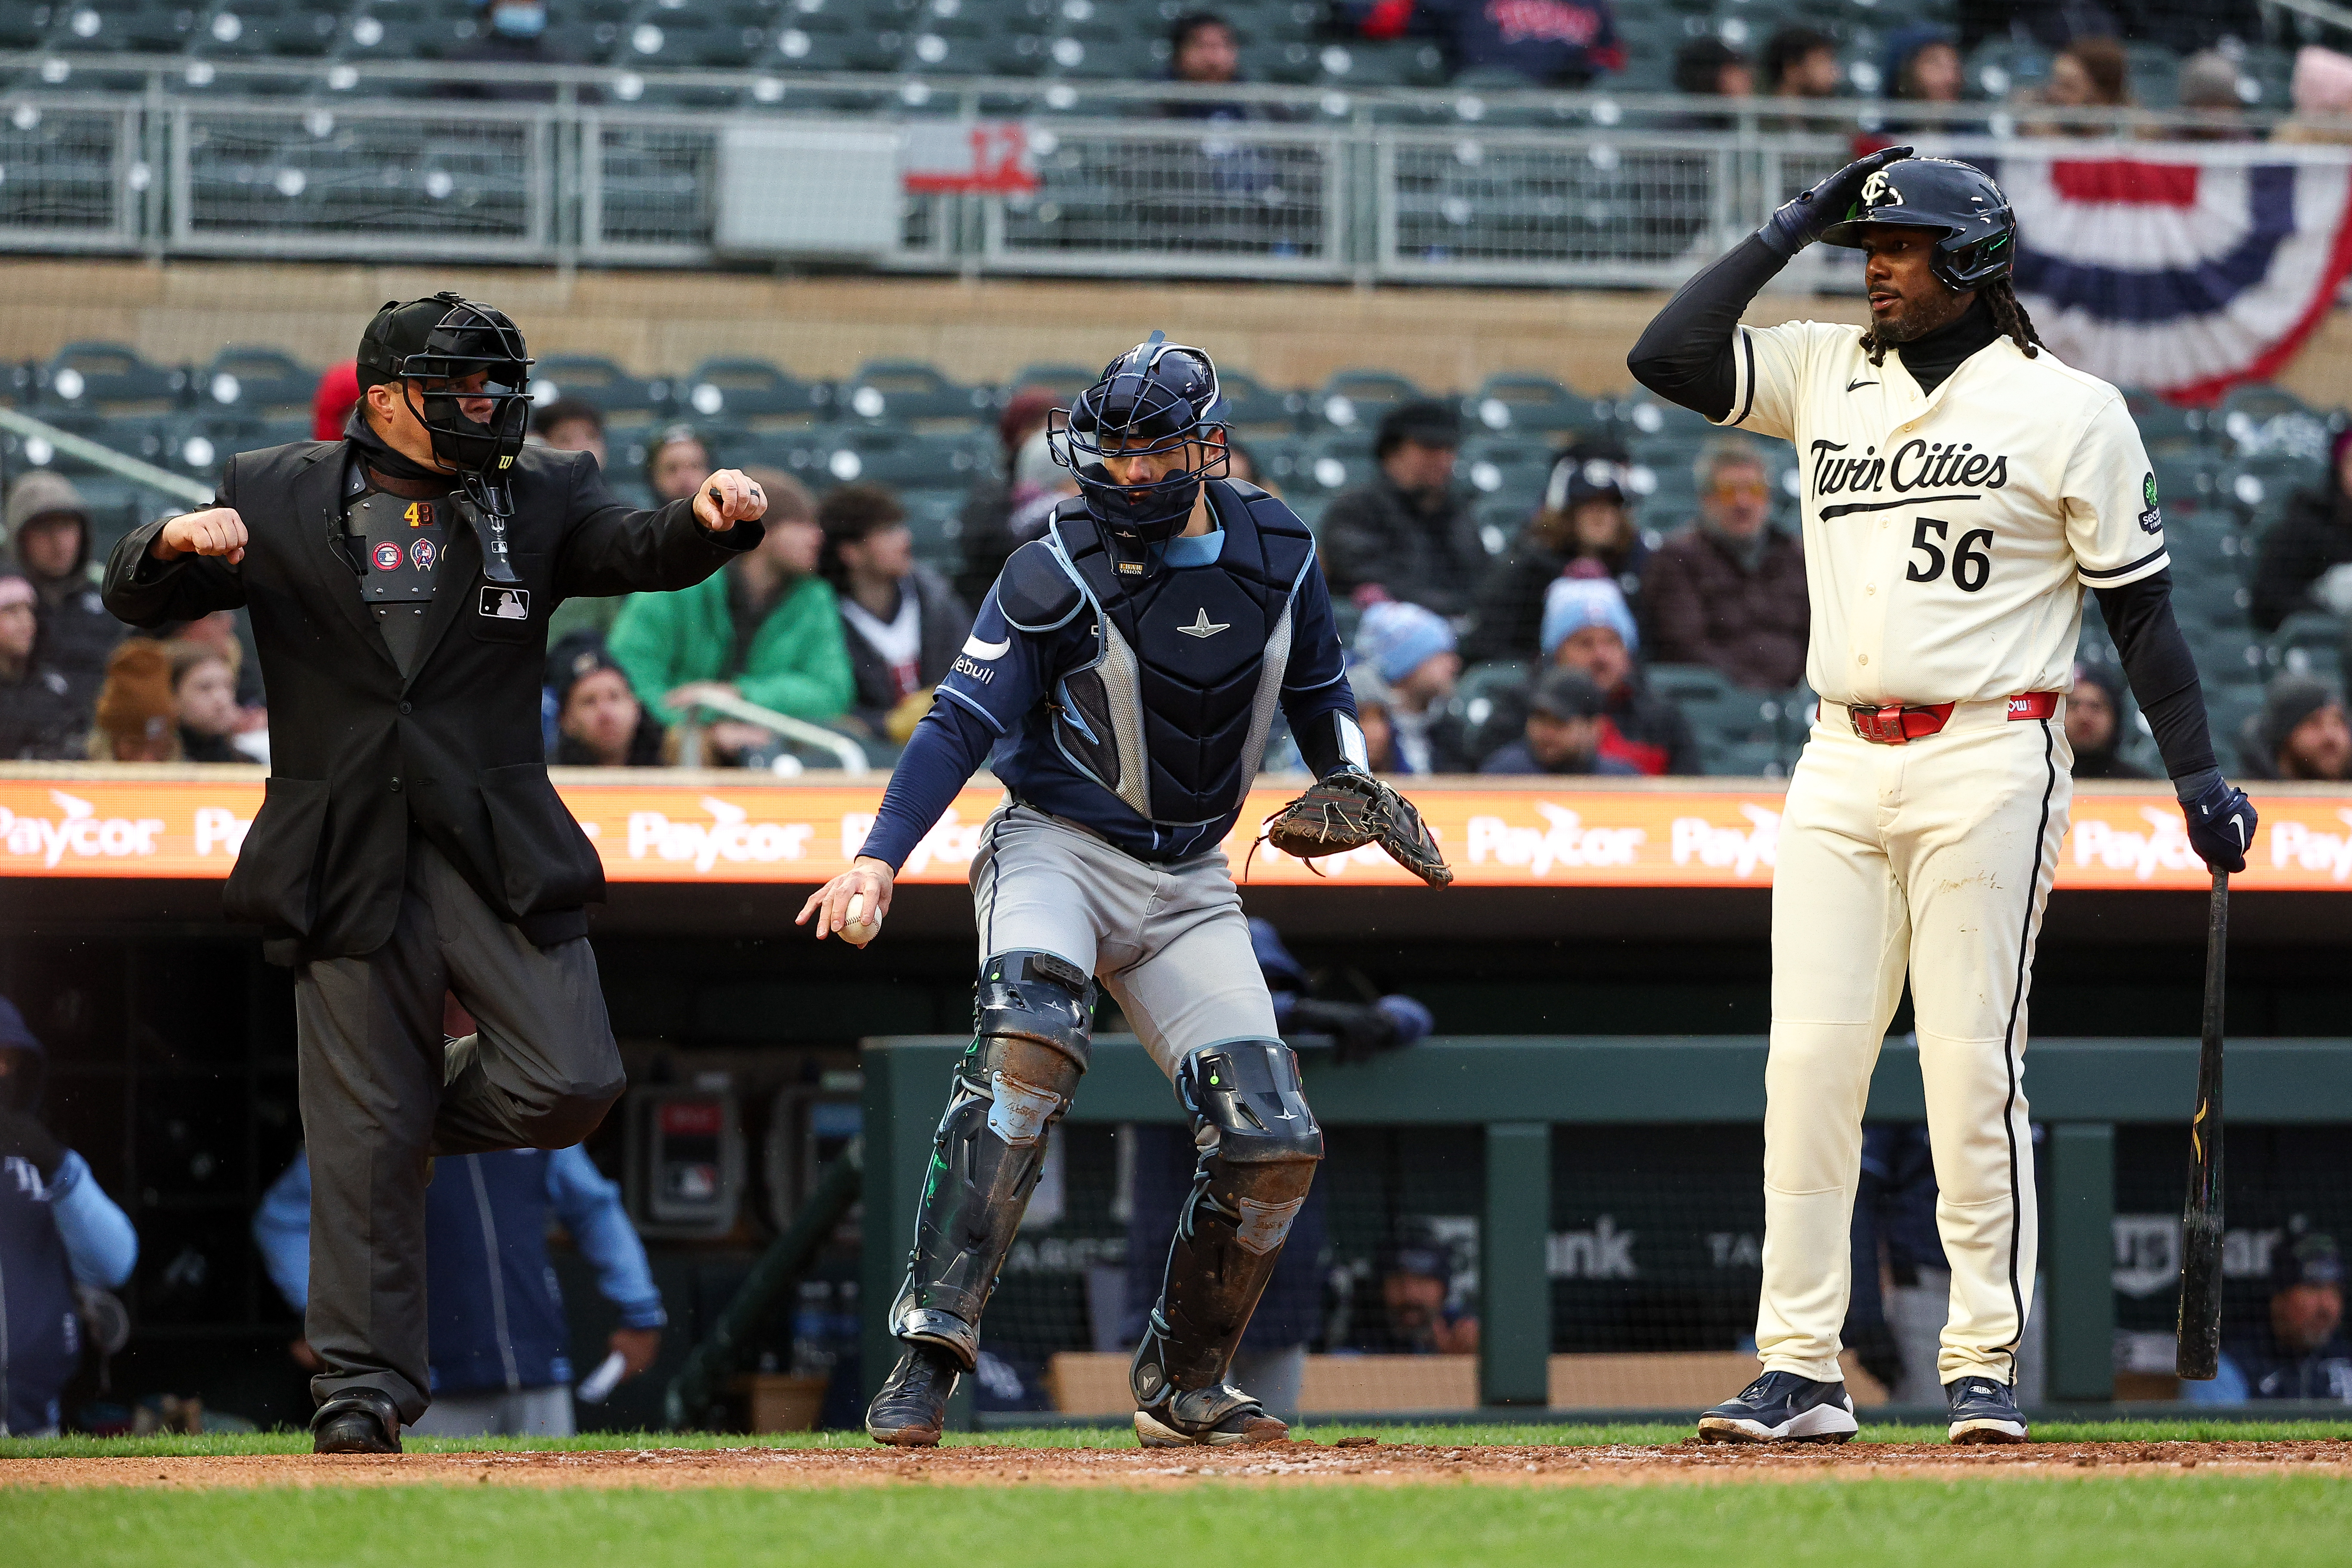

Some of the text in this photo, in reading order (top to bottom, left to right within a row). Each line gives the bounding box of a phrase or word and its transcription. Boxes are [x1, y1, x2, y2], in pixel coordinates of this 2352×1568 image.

[1811, 439, 2008, 502] Twin Cities
[404, 502, 434, 528] 48
[374, 542, 394, 552] MEMORIAL
[1906, 517, 1994, 592] 56
[2201, 804, 2209, 815] NIKE
[627, 810, 813, 872] Paycor
[1467, 815, 1646, 875] Paycor
